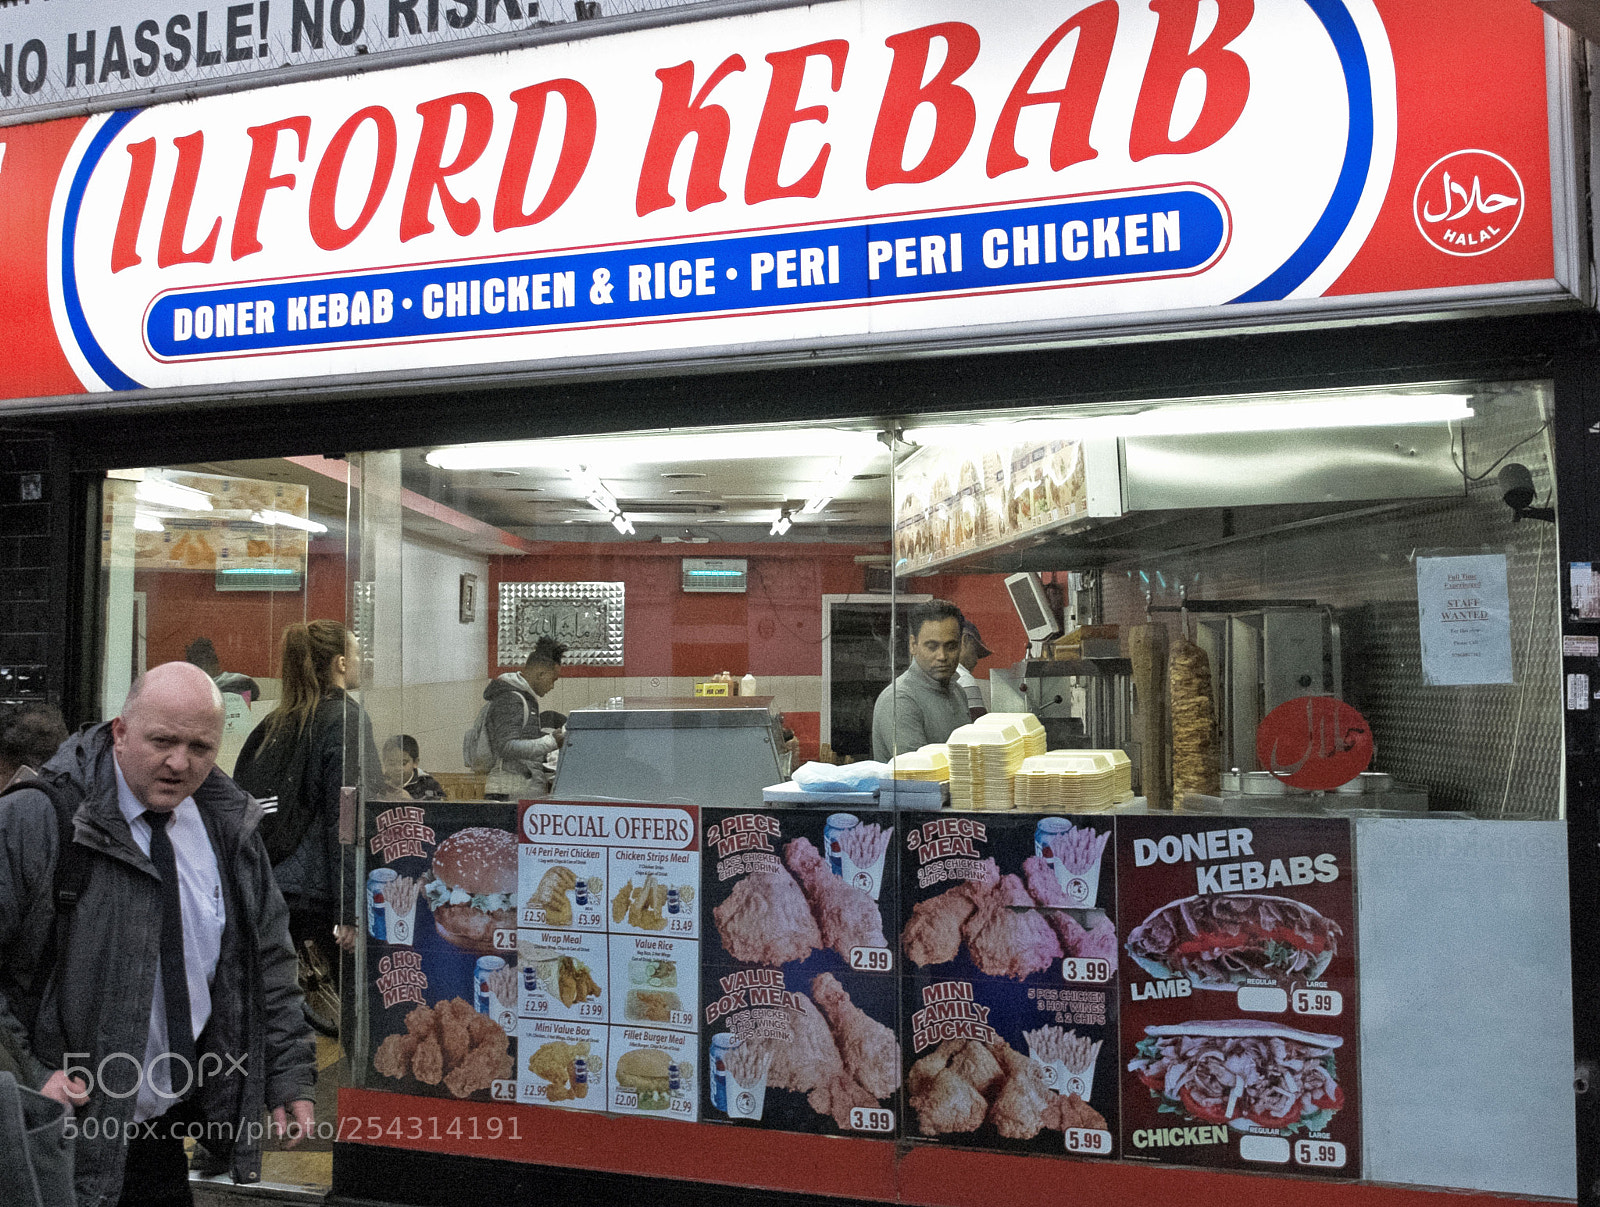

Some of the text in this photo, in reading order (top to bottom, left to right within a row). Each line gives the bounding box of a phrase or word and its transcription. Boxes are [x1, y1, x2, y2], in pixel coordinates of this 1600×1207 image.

[66, 0, 270, 88] HASSLE!
[291, 0, 366, 53] NO
[111, 0, 1255, 274] ILFORD KEBAB
[1443, 225, 1501, 245] HALAL
[173, 210, 1181, 342] DONER KEBAB CHICKEN & RICE PERI PERI CHICKEN
[1447, 598, 1481, 608] STAFF
[1441, 610, 1489, 620] WANTED
[376, 806, 425, 832] FILLET
[528, 813, 689, 842] SPECIAL OFFERS
[370, 823, 436, 855] BURGER
[707, 813, 781, 847] 2 PIECE
[907, 818, 988, 850] 3 PIECE
[383, 840, 427, 864] MEAL
[525, 847, 600, 859] 1/4 Peri Peri Chicken
[718, 832, 774, 858] MEAL
[918, 837, 980, 865] MEAL
[1133, 827, 1254, 867] DONER
[615, 850, 690, 864] Chicken Strips Meal
[742, 852, 781, 865] CHICKEN
[924, 860, 944, 875] PCS
[945, 858, 987, 872] CHICKEN
[719, 864, 745, 881] CHIPS
[753, 862, 780, 874] DRINK
[919, 868, 987, 889] CHIPS & DRINK
[1196, 853, 1340, 895] KEBABS
[524, 910, 546, 923] £2.50
[578, 913, 600, 925] £3.99
[670, 919, 693, 931] £3.49
[541, 932, 582, 944] Wrap Meal
[635, 938, 674, 951] Value Rice
[379, 950, 423, 974] 6 HOT
[853, 949, 888, 970] 2.99
[376, 967, 428, 993] WINGS
[1067, 960, 1108, 981] 3.99
[720, 968, 786, 994] VALUE
[1130, 978, 1193, 1001] LAMB
[1246, 978, 1277, 986] REGULAR
[1306, 980, 1328, 988] LARGE
[383, 984, 427, 1009] MEAL
[922, 981, 974, 1006] MINI
[1036, 989, 1059, 1000] PCS
[1059, 989, 1106, 1003] CHICKEN
[1298, 993, 1332, 1013] 5.99
[525, 1000, 548, 1012] £2.99
[706, 987, 807, 1024] BOX MEAL
[751, 1008, 790, 1022] CHICKEN
[1037, 1000, 1106, 1014] 3 HOT WINGS
[671, 1012, 693, 1025] £1.99
[756, 1019, 787, 1030] WINGS
[911, 1000, 991, 1033] FAMILY
[1055, 1012, 1106, 1026] & 2 CHIPS
[534, 1022, 591, 1036] Mini Value Box
[623, 1029, 686, 1045] Fillet Burger Meal
[729, 1030, 754, 1045] CHIPS
[764, 1029, 791, 1041] DRINK
[913, 1020, 996, 1054] BUCKET
[524, 1084, 546, 1096] £2.99
[615, 1094, 637, 1107] £2.00
[671, 1099, 692, 1113] £2.99
[853, 1110, 890, 1130] 3.99
[1069, 1131, 1102, 1150] 5.99
[1132, 1125, 1229, 1149] CHICKEN
[1249, 1126, 1280, 1136] REGULAR
[1308, 1131, 1331, 1139] LARGE
[1299, 1144, 1336, 1164] 5.99
